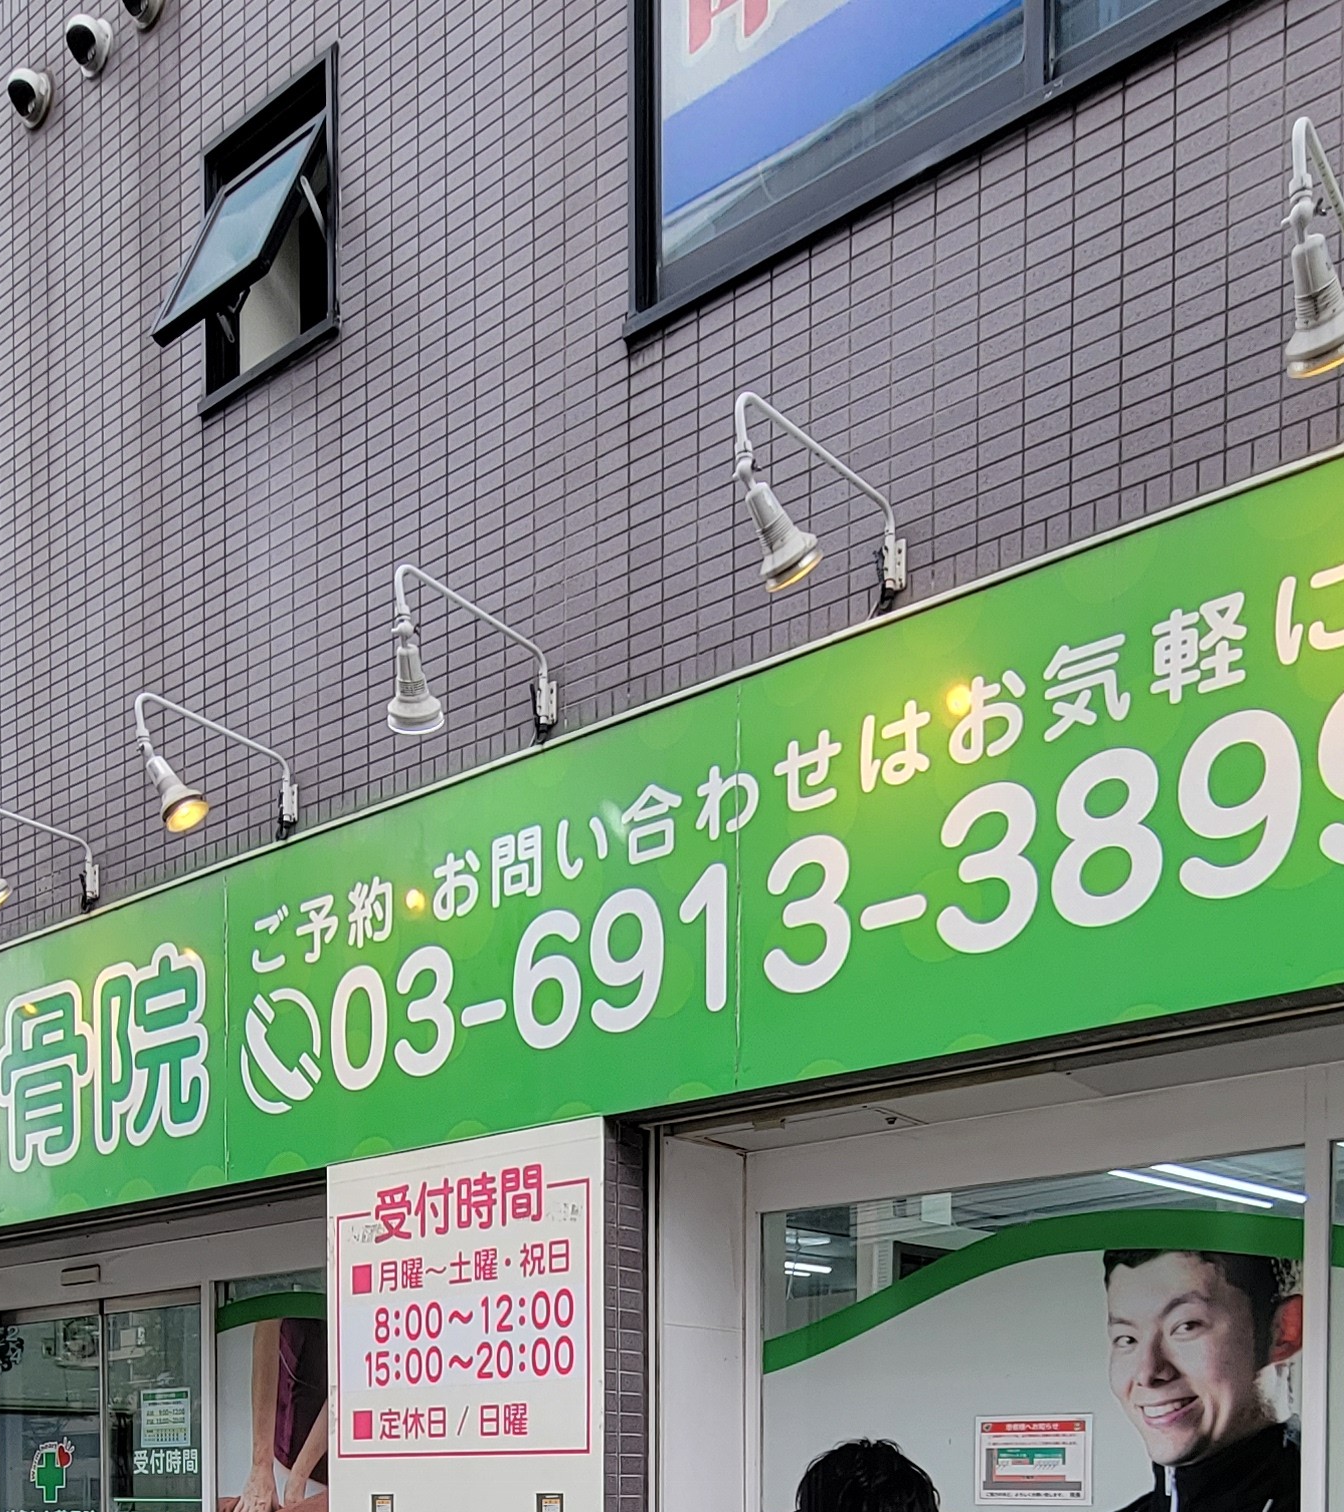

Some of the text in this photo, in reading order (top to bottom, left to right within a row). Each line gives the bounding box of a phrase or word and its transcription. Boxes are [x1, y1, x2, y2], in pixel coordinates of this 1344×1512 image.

[375, 1164, 543, 1243] 受付時間
[379, 1406, 448, 1441] 定休日
[479, 1404, 529, 1438] 日曜
[133, 1449, 198, 1474] 受付時間
